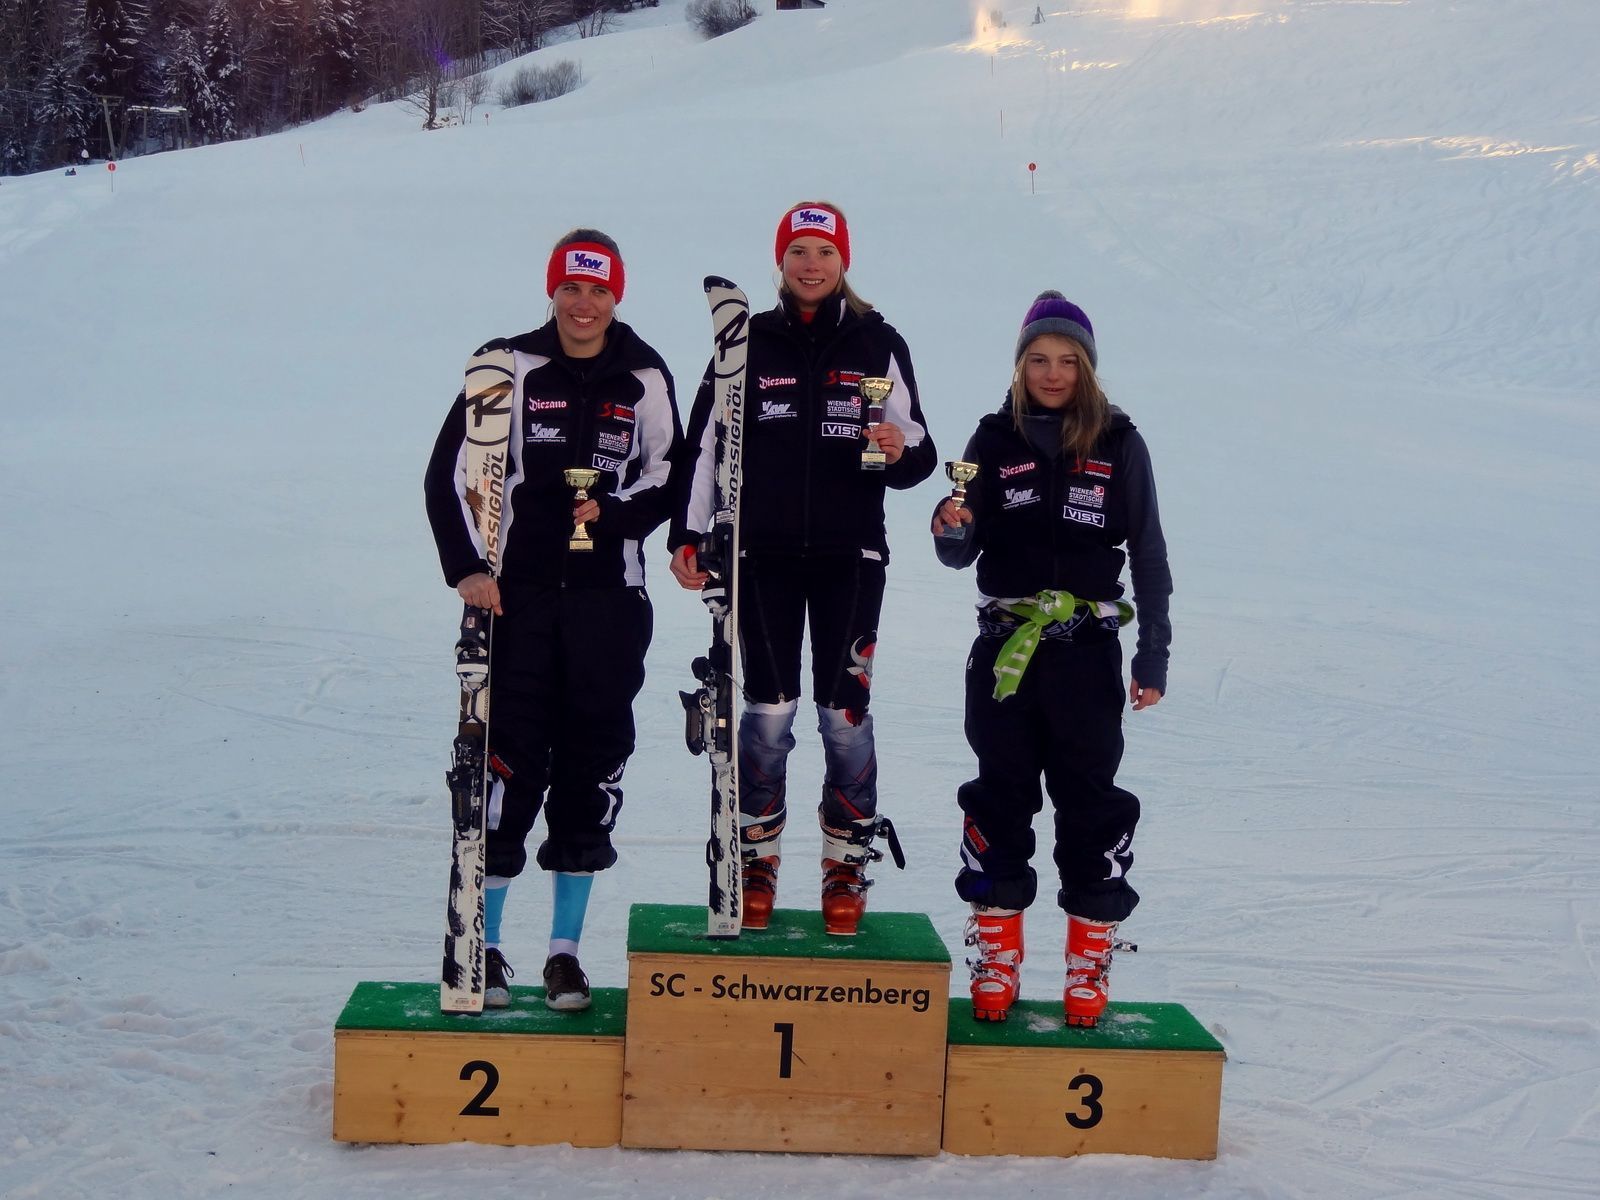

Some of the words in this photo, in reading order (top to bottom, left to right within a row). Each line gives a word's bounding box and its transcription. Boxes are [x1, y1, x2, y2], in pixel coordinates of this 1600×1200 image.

[827, 399, 850, 408] WIENER
[1069, 486, 1094, 496] WIENER
[649, 972, 686, 998] SC
[711, 973, 931, 1013] Schwarzenberg
[773, 1022, 794, 1079] 1
[458, 1060, 500, 1117] 2
[1065, 1073, 1104, 1130] 3
